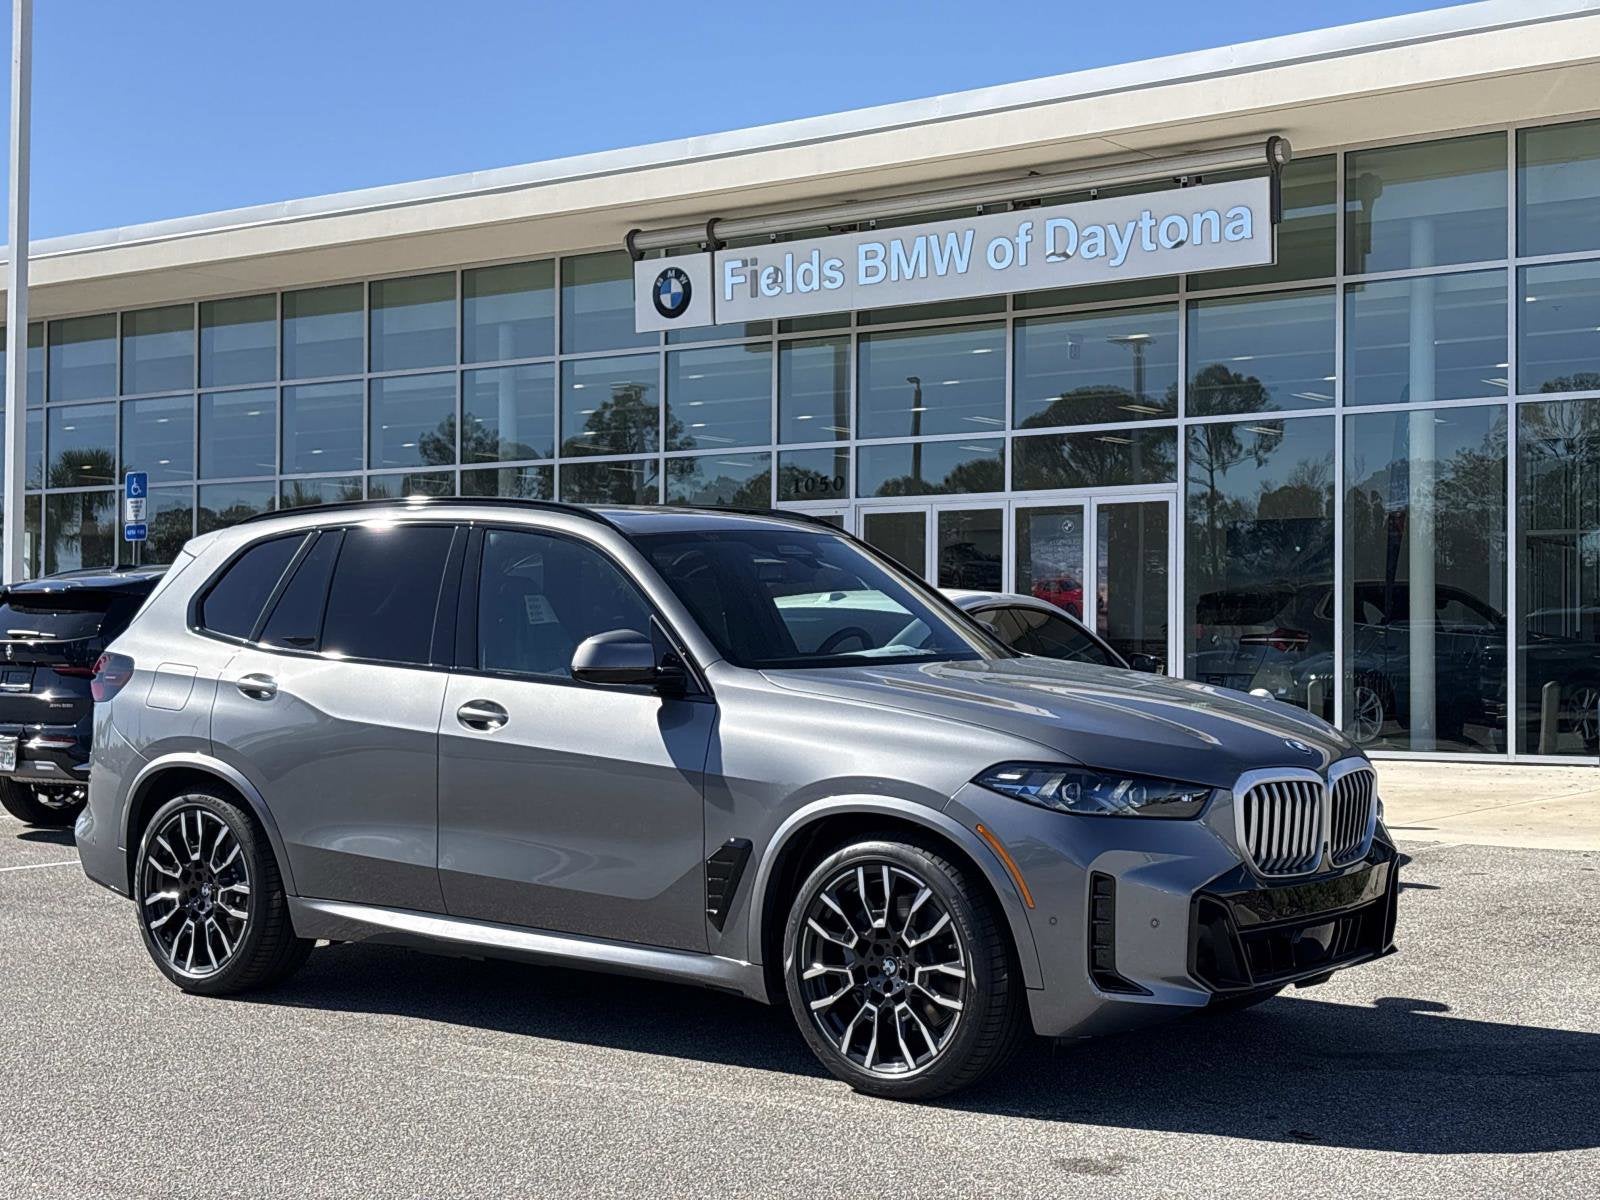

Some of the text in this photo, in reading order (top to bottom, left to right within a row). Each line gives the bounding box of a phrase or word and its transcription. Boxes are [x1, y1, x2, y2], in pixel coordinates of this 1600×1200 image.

[723, 204, 1254, 301] Fields BMW of Daytona
[793, 475, 845, 493] 1050
